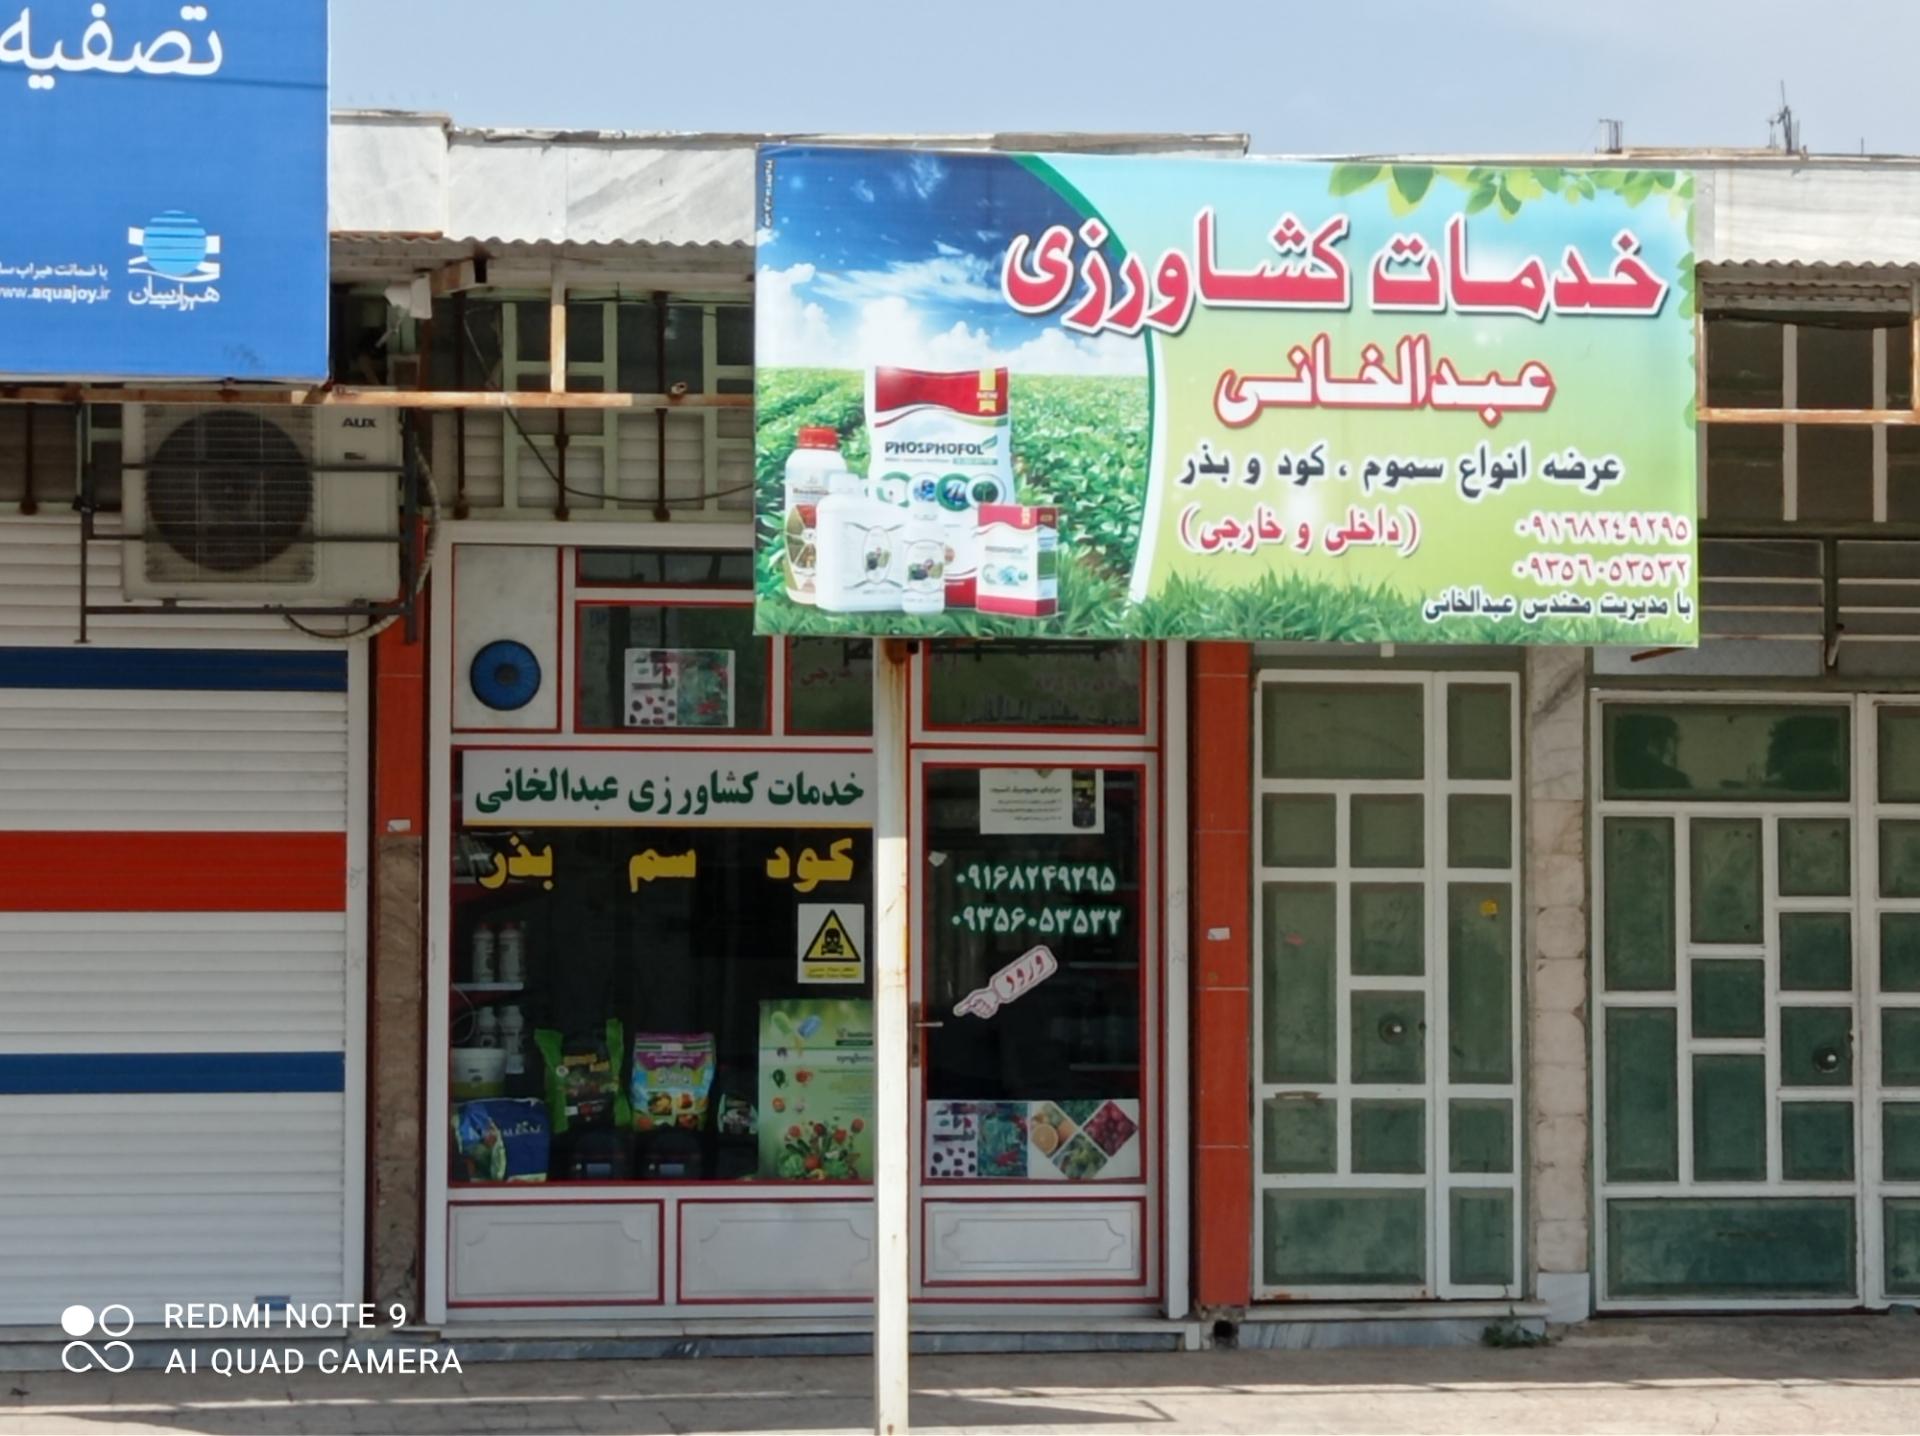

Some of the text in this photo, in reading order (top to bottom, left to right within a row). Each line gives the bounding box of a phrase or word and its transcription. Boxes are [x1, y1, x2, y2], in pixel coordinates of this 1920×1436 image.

[0, 2, 223, 89] تصفیه
[55, 263, 97, 277] ضمانت
[98, 263, 109, 281] با
[1005, 206, 1667, 333] خدمات کشاورزی
[0, 285, 111, 304] ww.aquajoy.ir
[1216, 333, 1555, 425] عبدالخانی
[342, 417, 376, 428] AUX
[885, 441, 985, 455] PHOSPHOFOL
[1180, 444, 1231, 485] بذر
[1246, 462, 1261, 486] و
[1278, 444, 1325, 490] کود
[1362, 455, 1443, 489] سموم
[1460, 446, 1527, 497] انواع
[1543, 456, 1621, 491] عرضه
[1180, 506, 1418, 555] (داخلی و خارجی)
[1424, 590, 1691, 621] با مدیریت مهندس عبدالخانی
[475, 765, 865, 815] خدمات کشاورزی عبدالخانی
[475, 833, 853, 893] کود سم بذر
[956, 864, 1116, 893] ۰۹۱۶۸۲۴۹۲۹۵
[952, 906, 1122, 935] ۰۹۳۵۶۰۵۳۵۳۲
[1005, 954, 1046, 994] ورود
